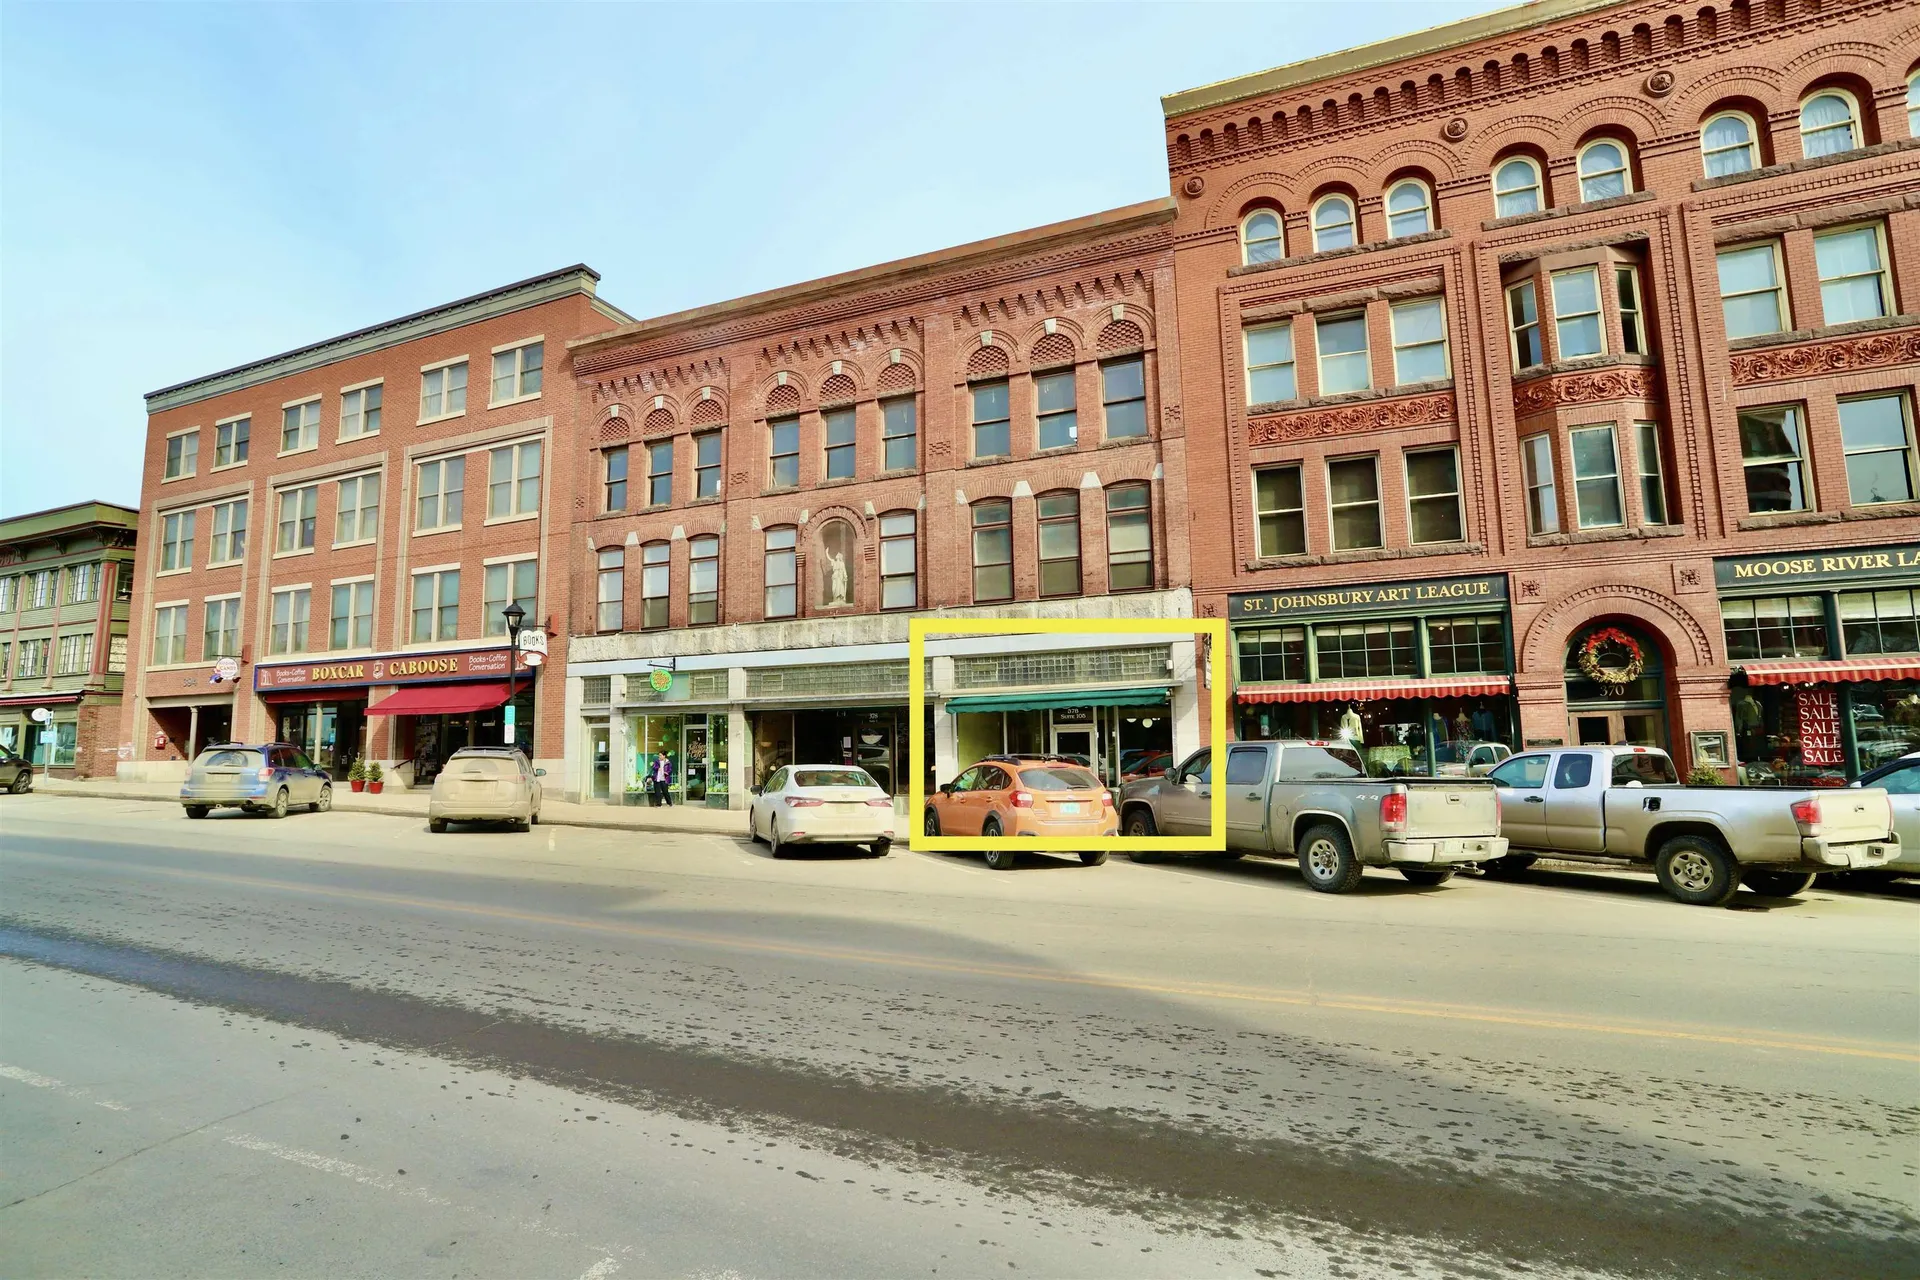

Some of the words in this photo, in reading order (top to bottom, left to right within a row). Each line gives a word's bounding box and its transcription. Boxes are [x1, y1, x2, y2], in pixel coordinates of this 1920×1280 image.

[1734, 559, 1816, 578] MOOSE
[1821, 553, 1892, 572] RIVER
[1243, 598, 1268, 612] ST.
[1270, 589, 1374, 614] JOHNSBURY
[1376, 587, 1411, 602] ART
[1416, 581, 1491, 599] LEAGUE
[522, 635, 545, 647] BOOKS
[312, 664, 364, 681] BOXCAR
[389, 657, 458, 676] CABOOSE
[468, 663, 506, 672] Conversation
[277, 676, 306, 684] Conversation
[1599, 684, 1625, 697] 370
[1798, 692, 1838, 706] SALE
[1800, 707, 1840, 720] SALE
[1801, 721, 1840, 734] SALE
[1804, 750, 1845, 763] SALE
